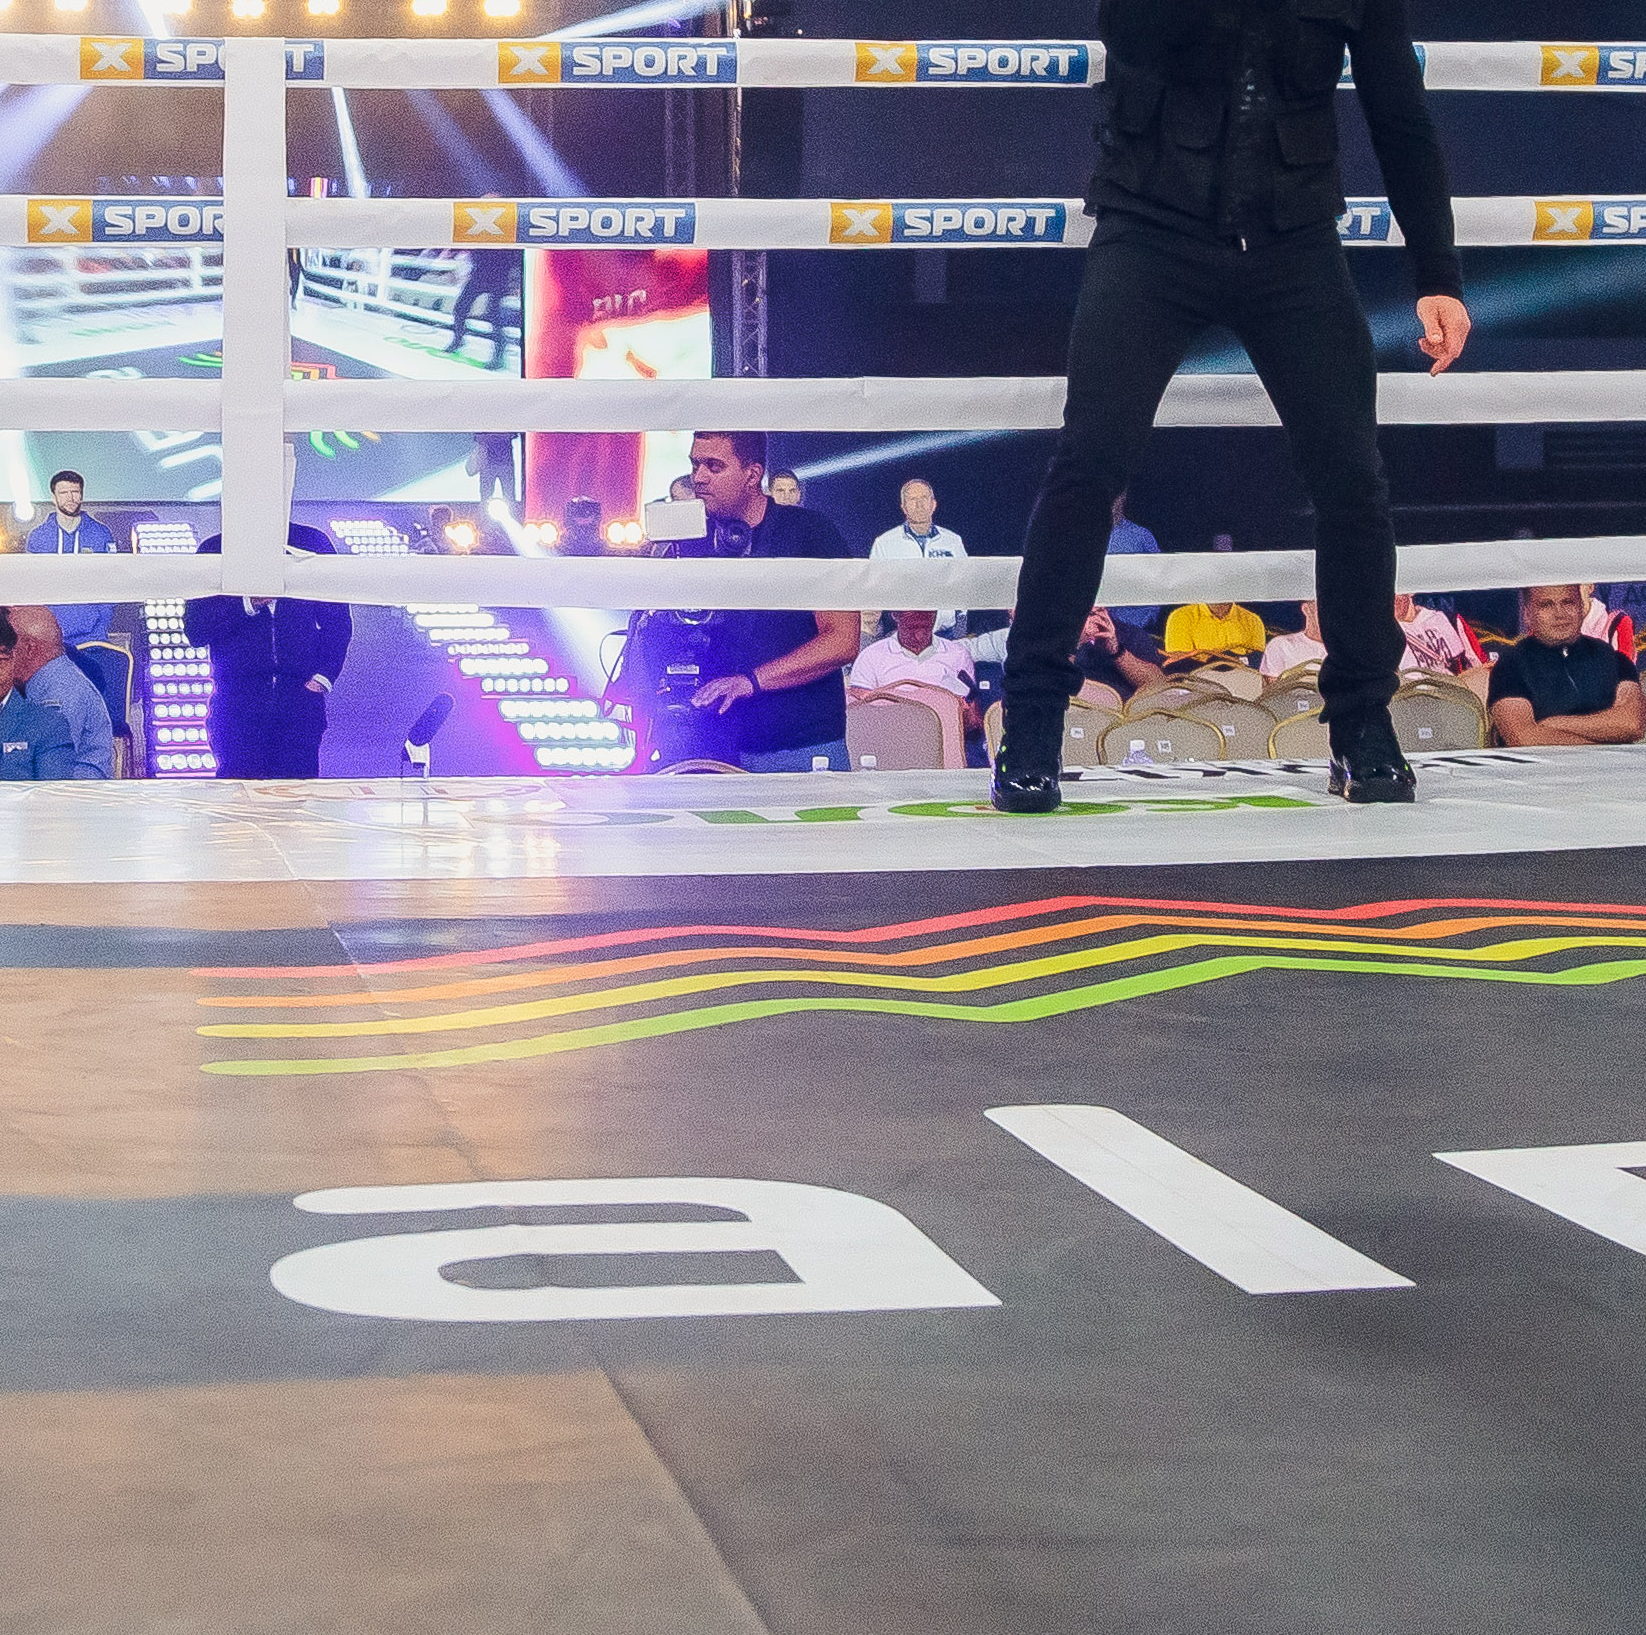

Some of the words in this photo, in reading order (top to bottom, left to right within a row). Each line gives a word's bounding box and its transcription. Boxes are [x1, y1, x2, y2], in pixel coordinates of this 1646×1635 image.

[156, 43, 314, 73] SPT
[572, 46, 728, 76] SPORT
[928, 47, 1078, 76] SPORT
[104, 204, 225, 236] SPOR
[529, 208, 686, 238] SPORT
[903, 208, 1056, 237] SPORT
